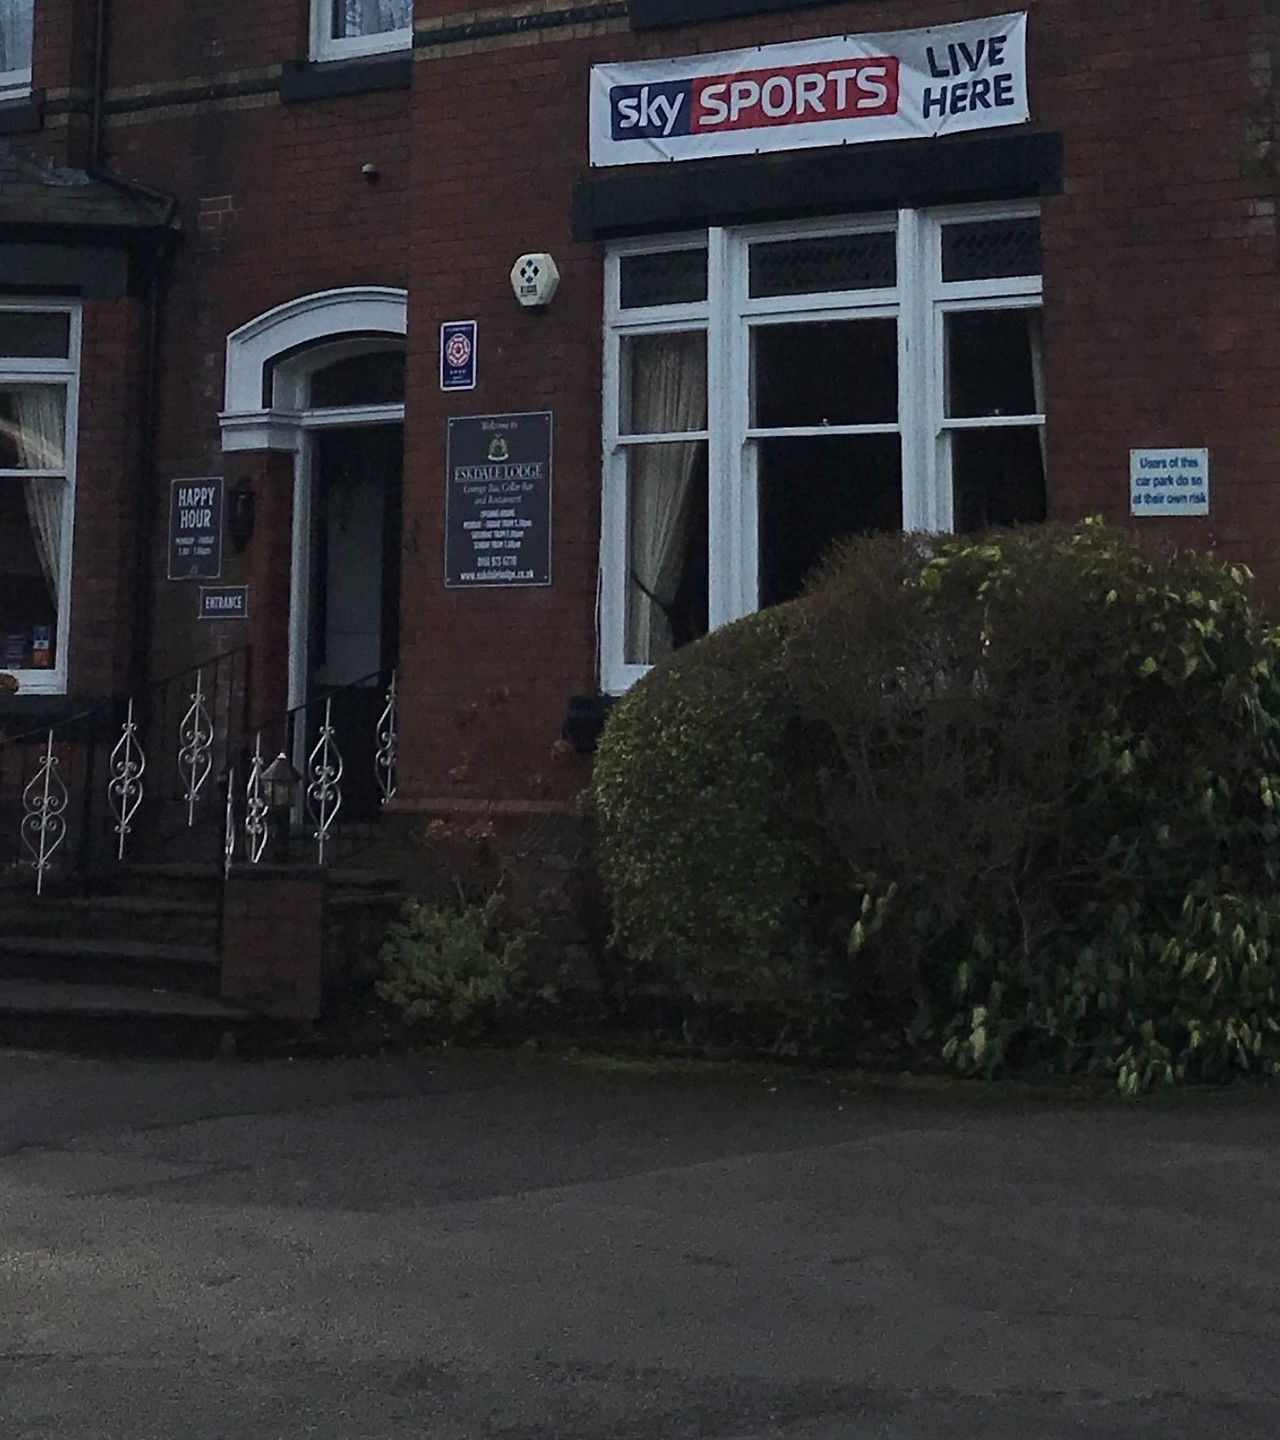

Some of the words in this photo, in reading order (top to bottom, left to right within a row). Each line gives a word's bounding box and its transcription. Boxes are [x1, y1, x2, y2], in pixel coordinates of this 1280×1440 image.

[926, 34, 1008, 79] LIVE
[619, 86, 685, 136] sky
[698, 66, 887, 126] SPORTS
[923, 73, 1015, 120] HERE
[1152, 475, 1175, 488] park
[1176, 475, 1189, 486] do
[178, 486, 216, 507] HAPPY
[180, 509, 212, 529] HOUR
[205, 594, 242, 610] ENTRANCE
